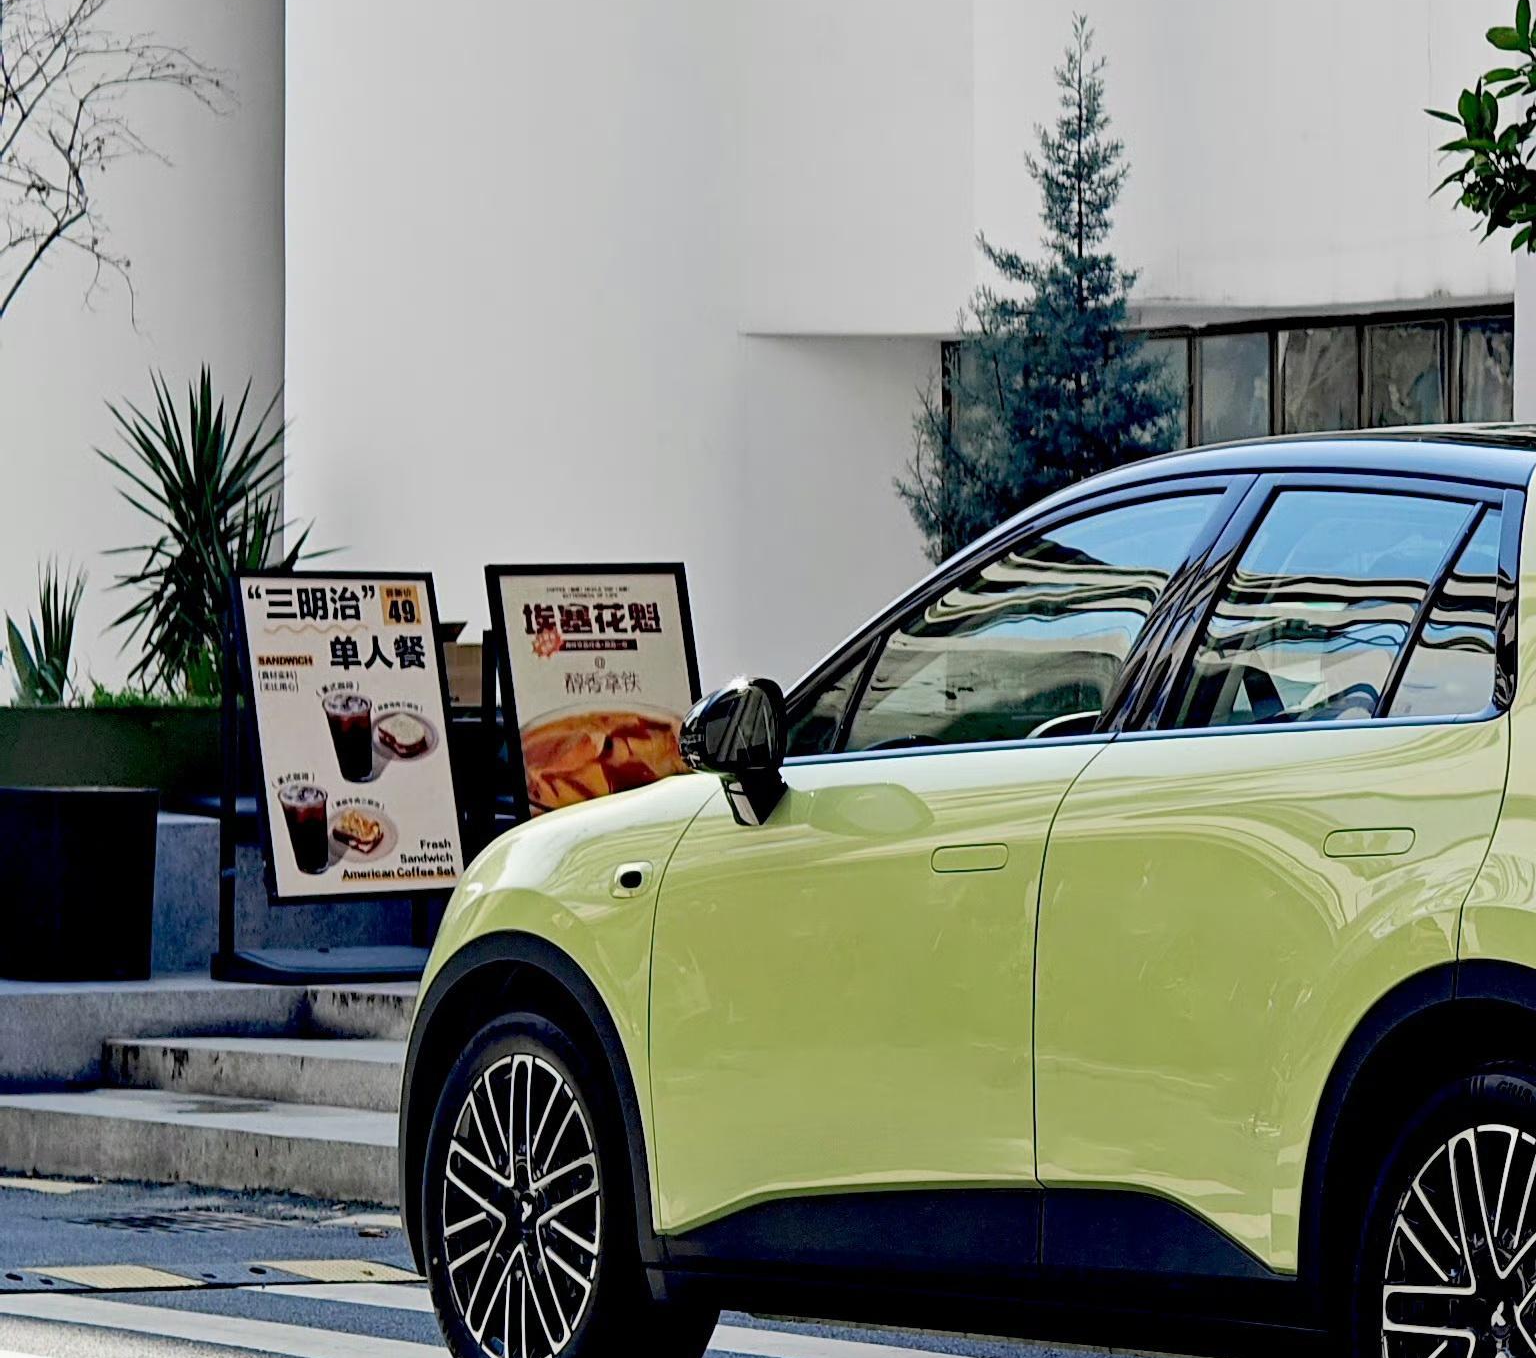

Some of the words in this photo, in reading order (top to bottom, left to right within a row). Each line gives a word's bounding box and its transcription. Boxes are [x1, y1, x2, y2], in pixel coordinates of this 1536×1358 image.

[329, 635, 426, 670] 单人餐
[419, 838, 452, 850] Fresh
[400, 853, 454, 864] Sandwich
[396, 866, 434, 877] Coffee
